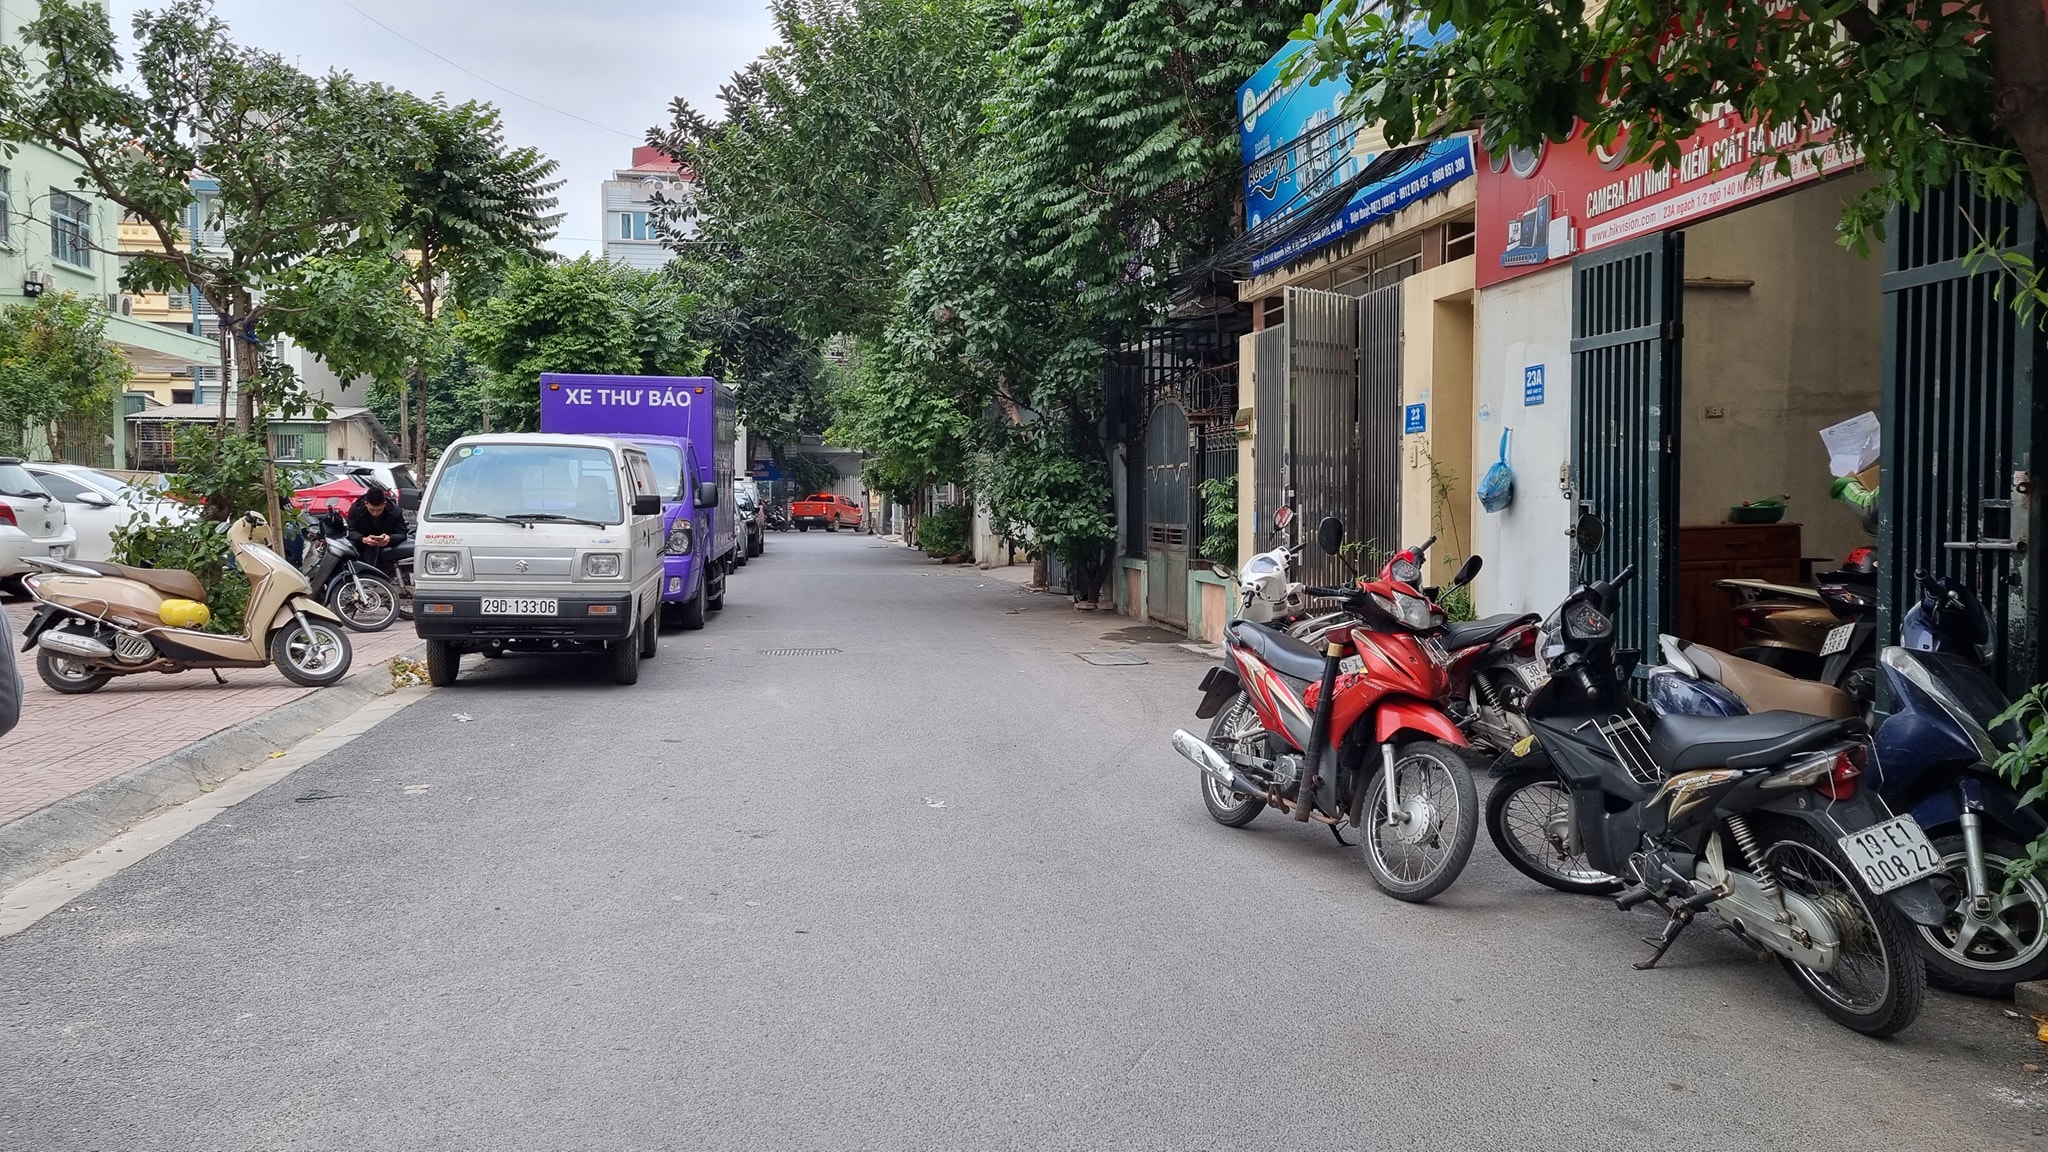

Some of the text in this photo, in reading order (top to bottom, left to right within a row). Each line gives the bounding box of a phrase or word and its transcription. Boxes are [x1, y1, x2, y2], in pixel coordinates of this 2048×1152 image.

[1587, 180, 1625, 219] CAMERA
[1627, 173, 1642, 203] AN
[1644, 161, 1671, 197] NINH
[1680, 136, 1710, 184] KIỂM
[1712, 127, 1745, 169] SOÁT
[1748, 123, 1765, 158] RA
[1591, 212, 1656, 243] www.hikvision.com
[1663, 203, 1675, 218] 23A
[1676, 197, 1695, 216] ngách
[1697, 192, 1707, 206] 1/2
[1708, 187, 1721, 205] ngõ
[1723, 182, 1736, 198] 140
[1527, 369, 1542, 387] 23A
[565, 386, 691, 407] XE THƯ BÁO
[1411, 408, 1420, 421] 23
[483, 599, 555, 614] 29D-133.06
[1856, 822, 1914, 860] 19-E1
[1865, 844, 1940, 887] 008.22
